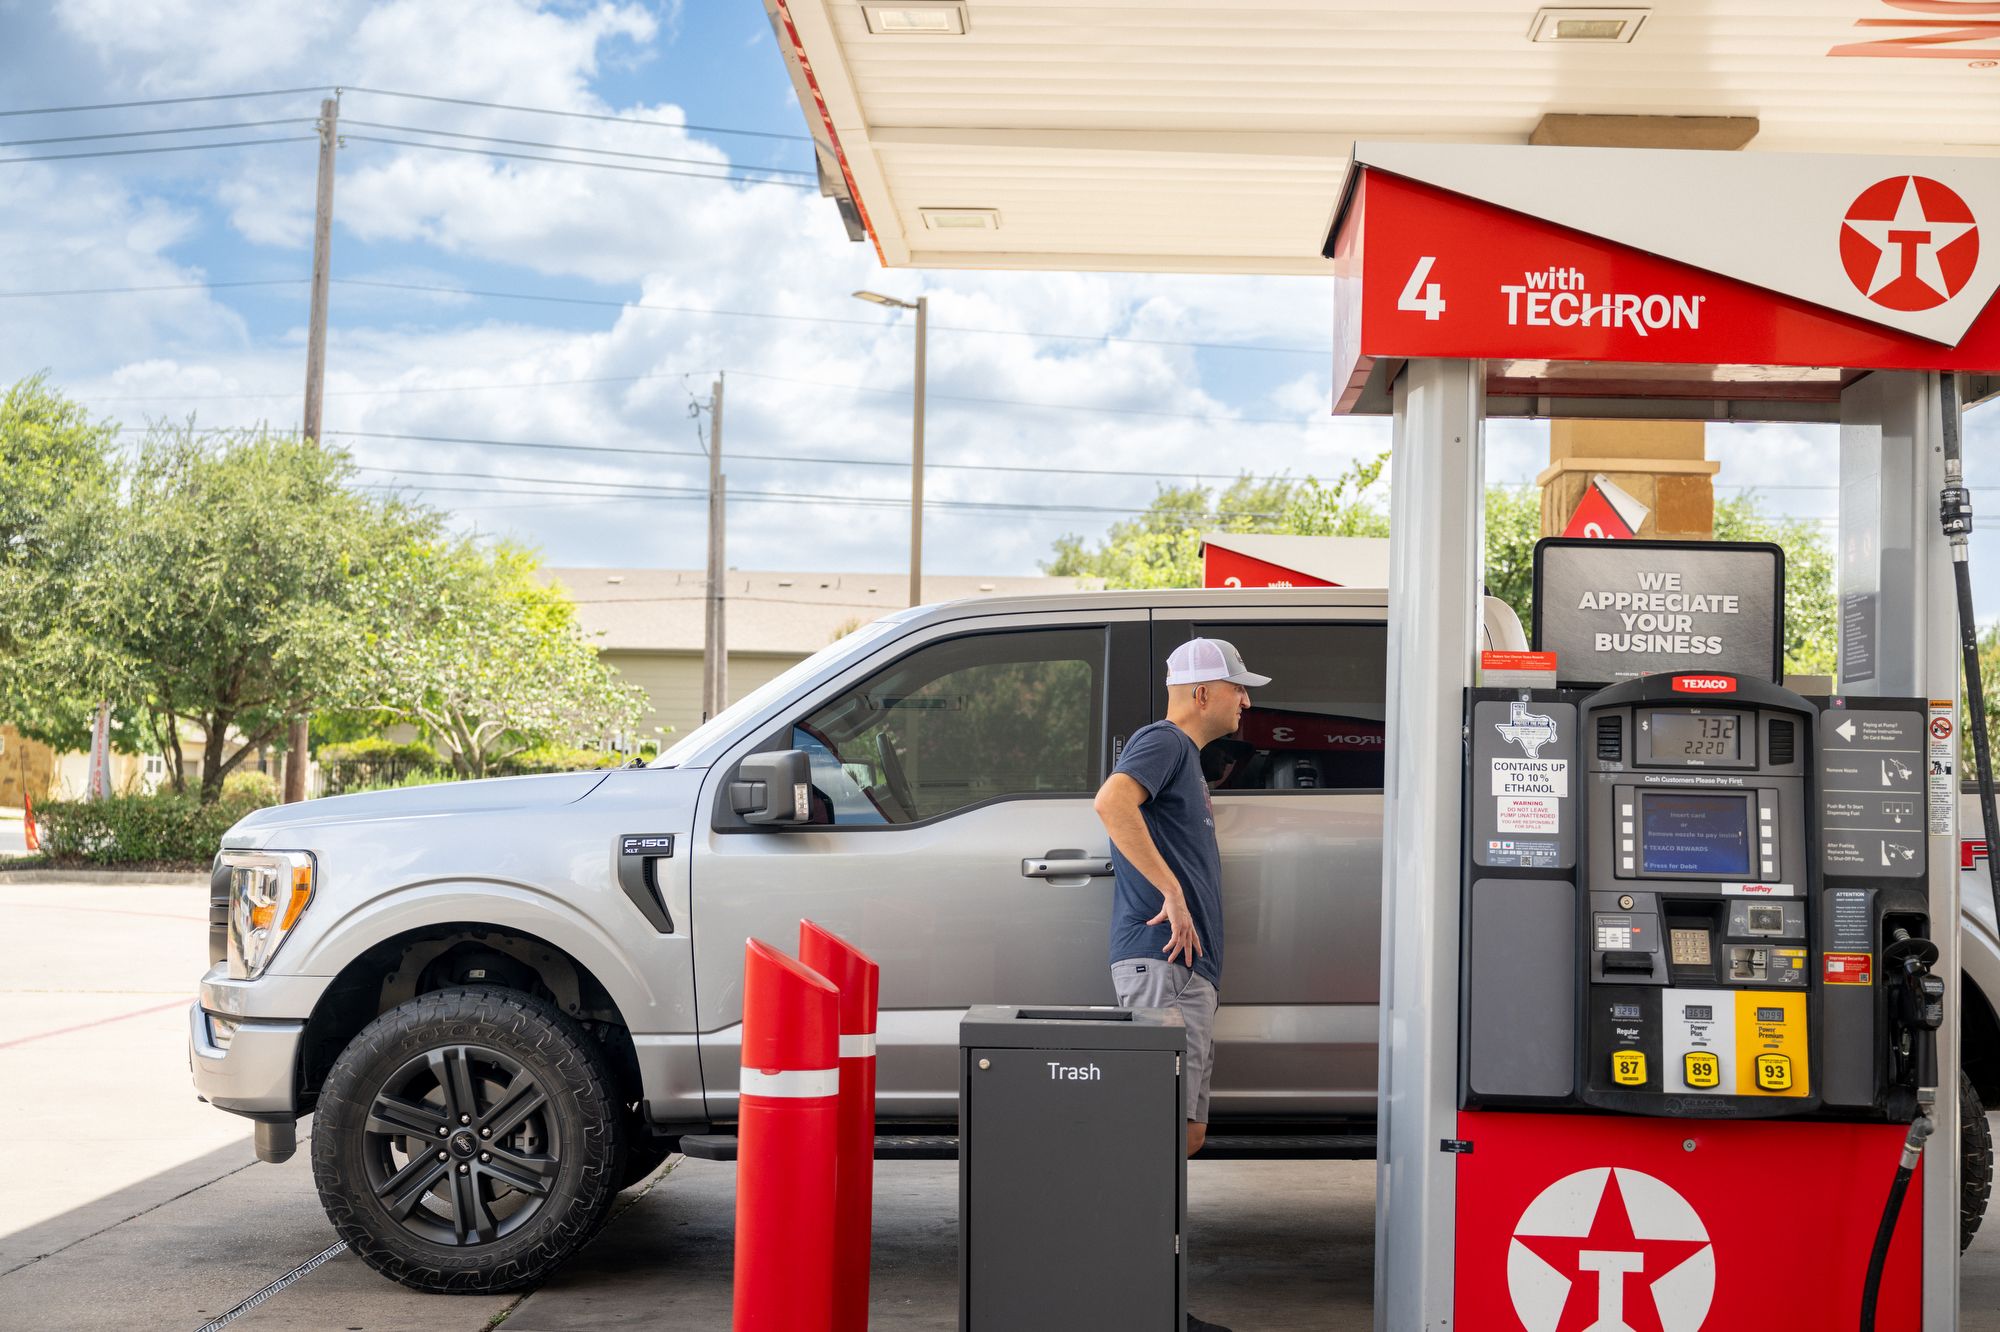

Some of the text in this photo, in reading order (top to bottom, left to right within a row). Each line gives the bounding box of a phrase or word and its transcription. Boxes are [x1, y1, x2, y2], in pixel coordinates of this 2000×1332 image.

[1524, 266, 1585, 290] with
[1397, 256, 1446, 321] 4
[1638, 572, 1682, 592] WE
[1578, 591, 1739, 614] APPRECIATE
[1620, 613, 1693, 633] YOUR
[1595, 633, 1723, 655] BUSINESS
[1682, 679, 1728, 690] TEXACO
[1642, 718, 1735, 739] $ 7.32
[1684, 741, 1725, 755] 2.220
[1493, 762, 1566, 772] CONTAINS UP
[1510, 773, 1525, 782] TO
[1661, 776, 1695, 784] Customers
[1695, 777, 1715, 785] Please
[1716, 778, 1729, 786] Pay
[1504, 783, 1556, 793] ETHANOL
[625, 839, 669, 848] F-150
[1742, 884, 1773, 894] FastPay
[1616, 1028, 1640, 1036] Regular
[1047, 1062, 1101, 1081] Trash
[1620, 1061, 1639, 1074] 87
[1692, 1062, 1712, 1076] 89
[1765, 1065, 1785, 1079] 93
